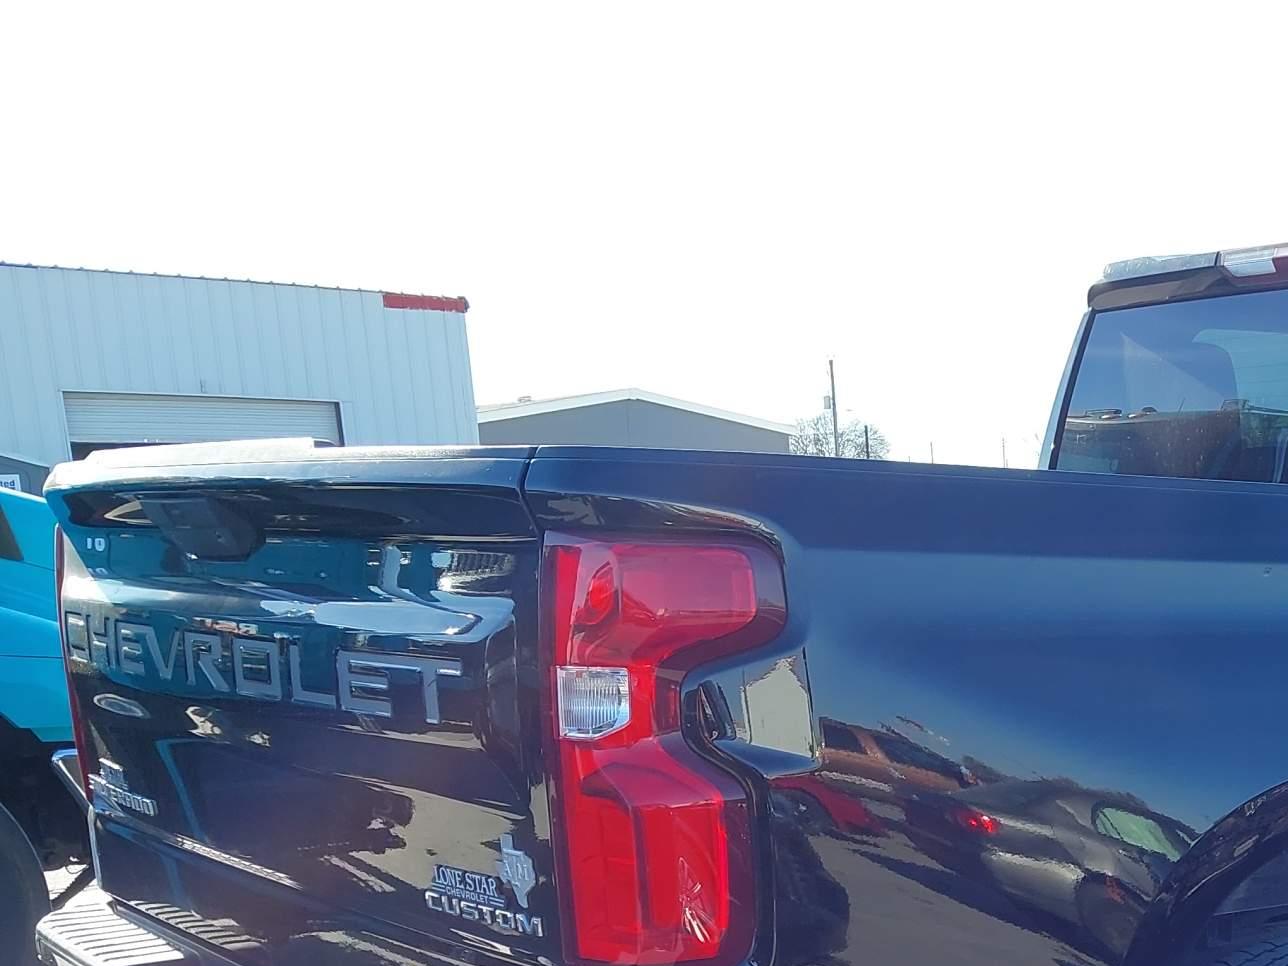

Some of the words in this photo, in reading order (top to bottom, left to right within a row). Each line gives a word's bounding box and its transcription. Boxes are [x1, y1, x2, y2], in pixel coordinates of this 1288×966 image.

[64, 608, 464, 725] CHEVROLET
[433, 865, 463, 889] LONE
[465, 873, 498, 897] STAR
[446, 886, 489, 904] CHEVROLET
[425, 890, 544, 937] CUSTOM
